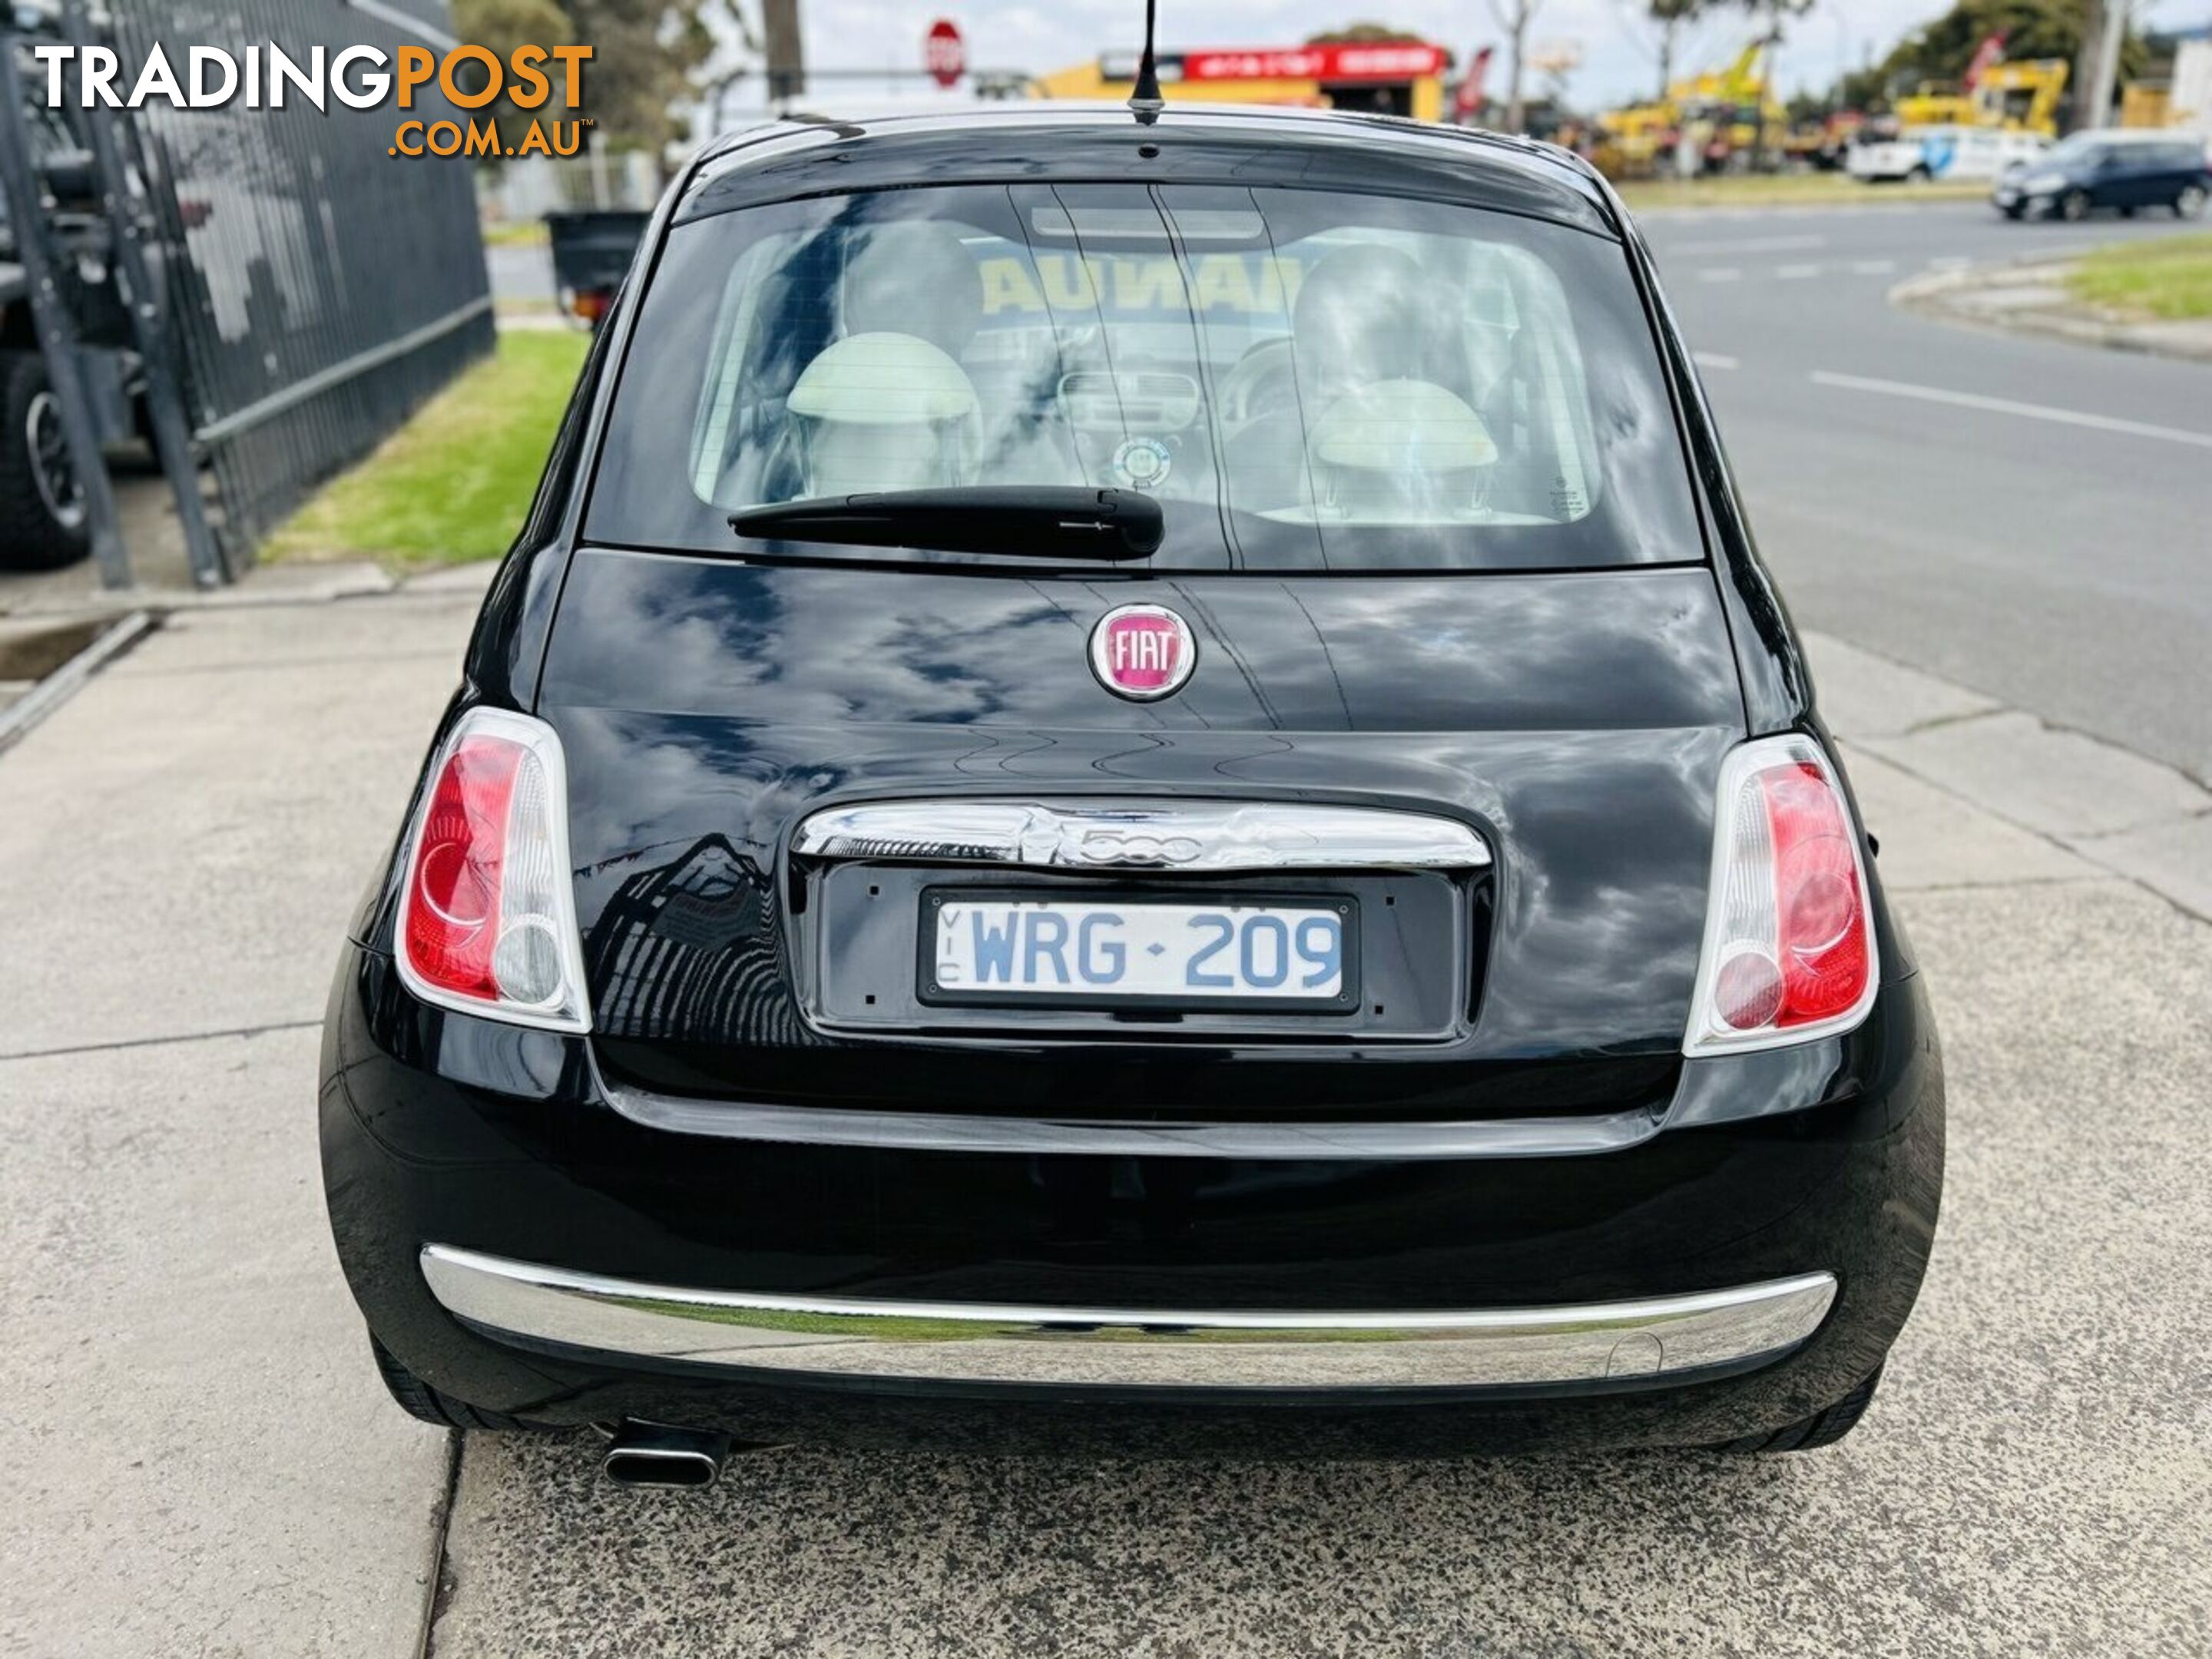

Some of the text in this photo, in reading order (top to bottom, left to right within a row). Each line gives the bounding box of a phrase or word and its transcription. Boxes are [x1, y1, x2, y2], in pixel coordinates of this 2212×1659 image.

[1116, 631, 1173, 670] FIAT
[1080, 830, 1203, 863] 500
[937, 909, 961, 982] VIC
[972, 911, 1342, 988] WRG 209
